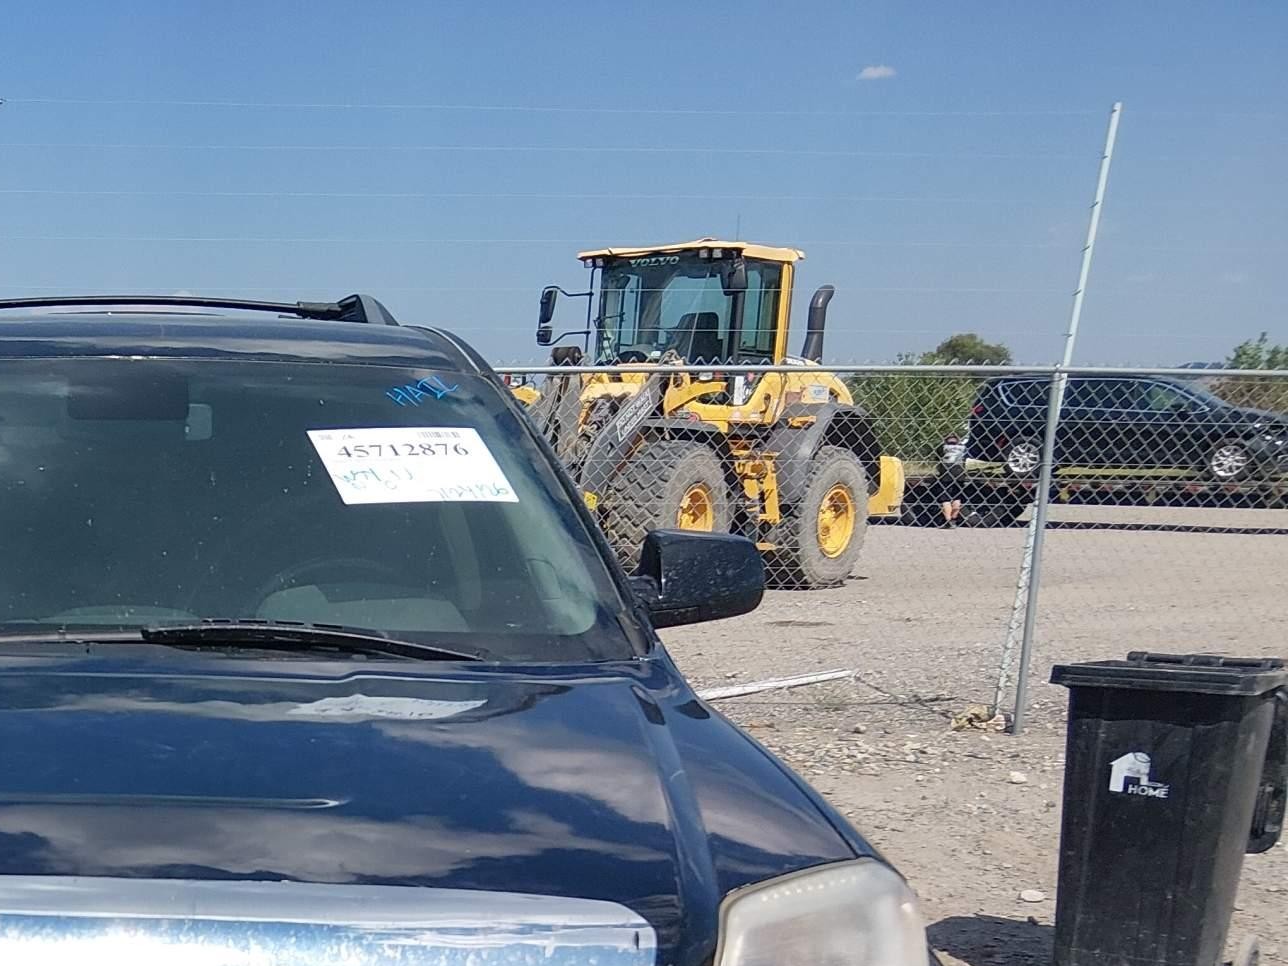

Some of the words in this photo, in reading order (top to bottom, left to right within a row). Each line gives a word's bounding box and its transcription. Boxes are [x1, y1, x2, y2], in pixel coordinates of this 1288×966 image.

[629, 256, 680, 268] VOLVO
[386, 376, 458, 407] HAIL
[337, 442, 469, 458] 45712876
[1127, 784, 1169, 798] HOME
